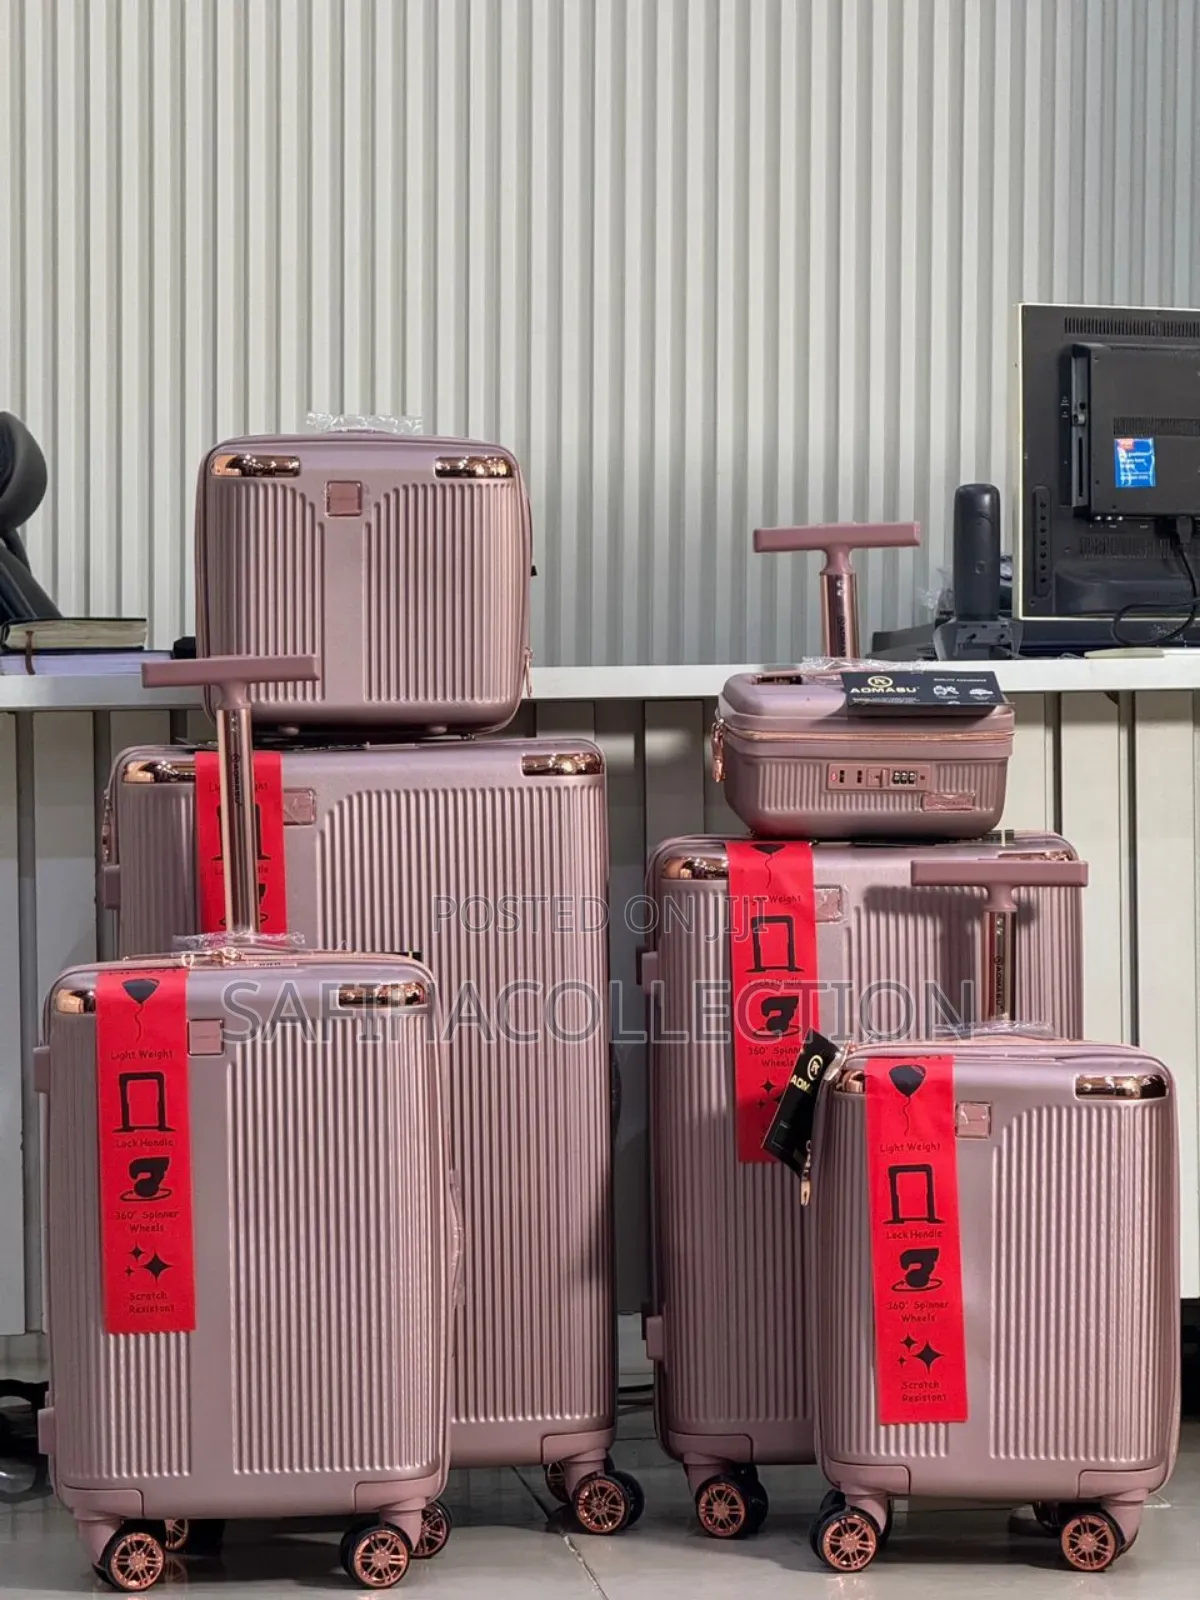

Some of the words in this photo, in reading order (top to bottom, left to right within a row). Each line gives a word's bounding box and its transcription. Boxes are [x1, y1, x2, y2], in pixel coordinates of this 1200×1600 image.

[850, 686, 917, 694] AOMASU
[769, 894, 801, 905] Weight
[111, 1050, 135, 1061] Light
[139, 1049, 173, 1060] Weight
[772, 1046, 801, 1056] Spinn
[116, 1139, 138, 1148] Lock
[880, 1144, 905, 1154] Light
[906, 1142, 941, 1154] Weight
[142, 1210, 179, 1222] Spinner
[129, 1224, 164, 1233] Wheels
[886, 1230, 908, 1239] Lock
[130, 1291, 167, 1301] Scratch
[129, 1304, 175, 1314] Resistant
[914, 1300, 949, 1312] Spinner
[901, 1313, 936, 1323] Wheels
[902, 1380, 940, 1389] Scratch
[902, 1393, 947, 1402] Resistant
